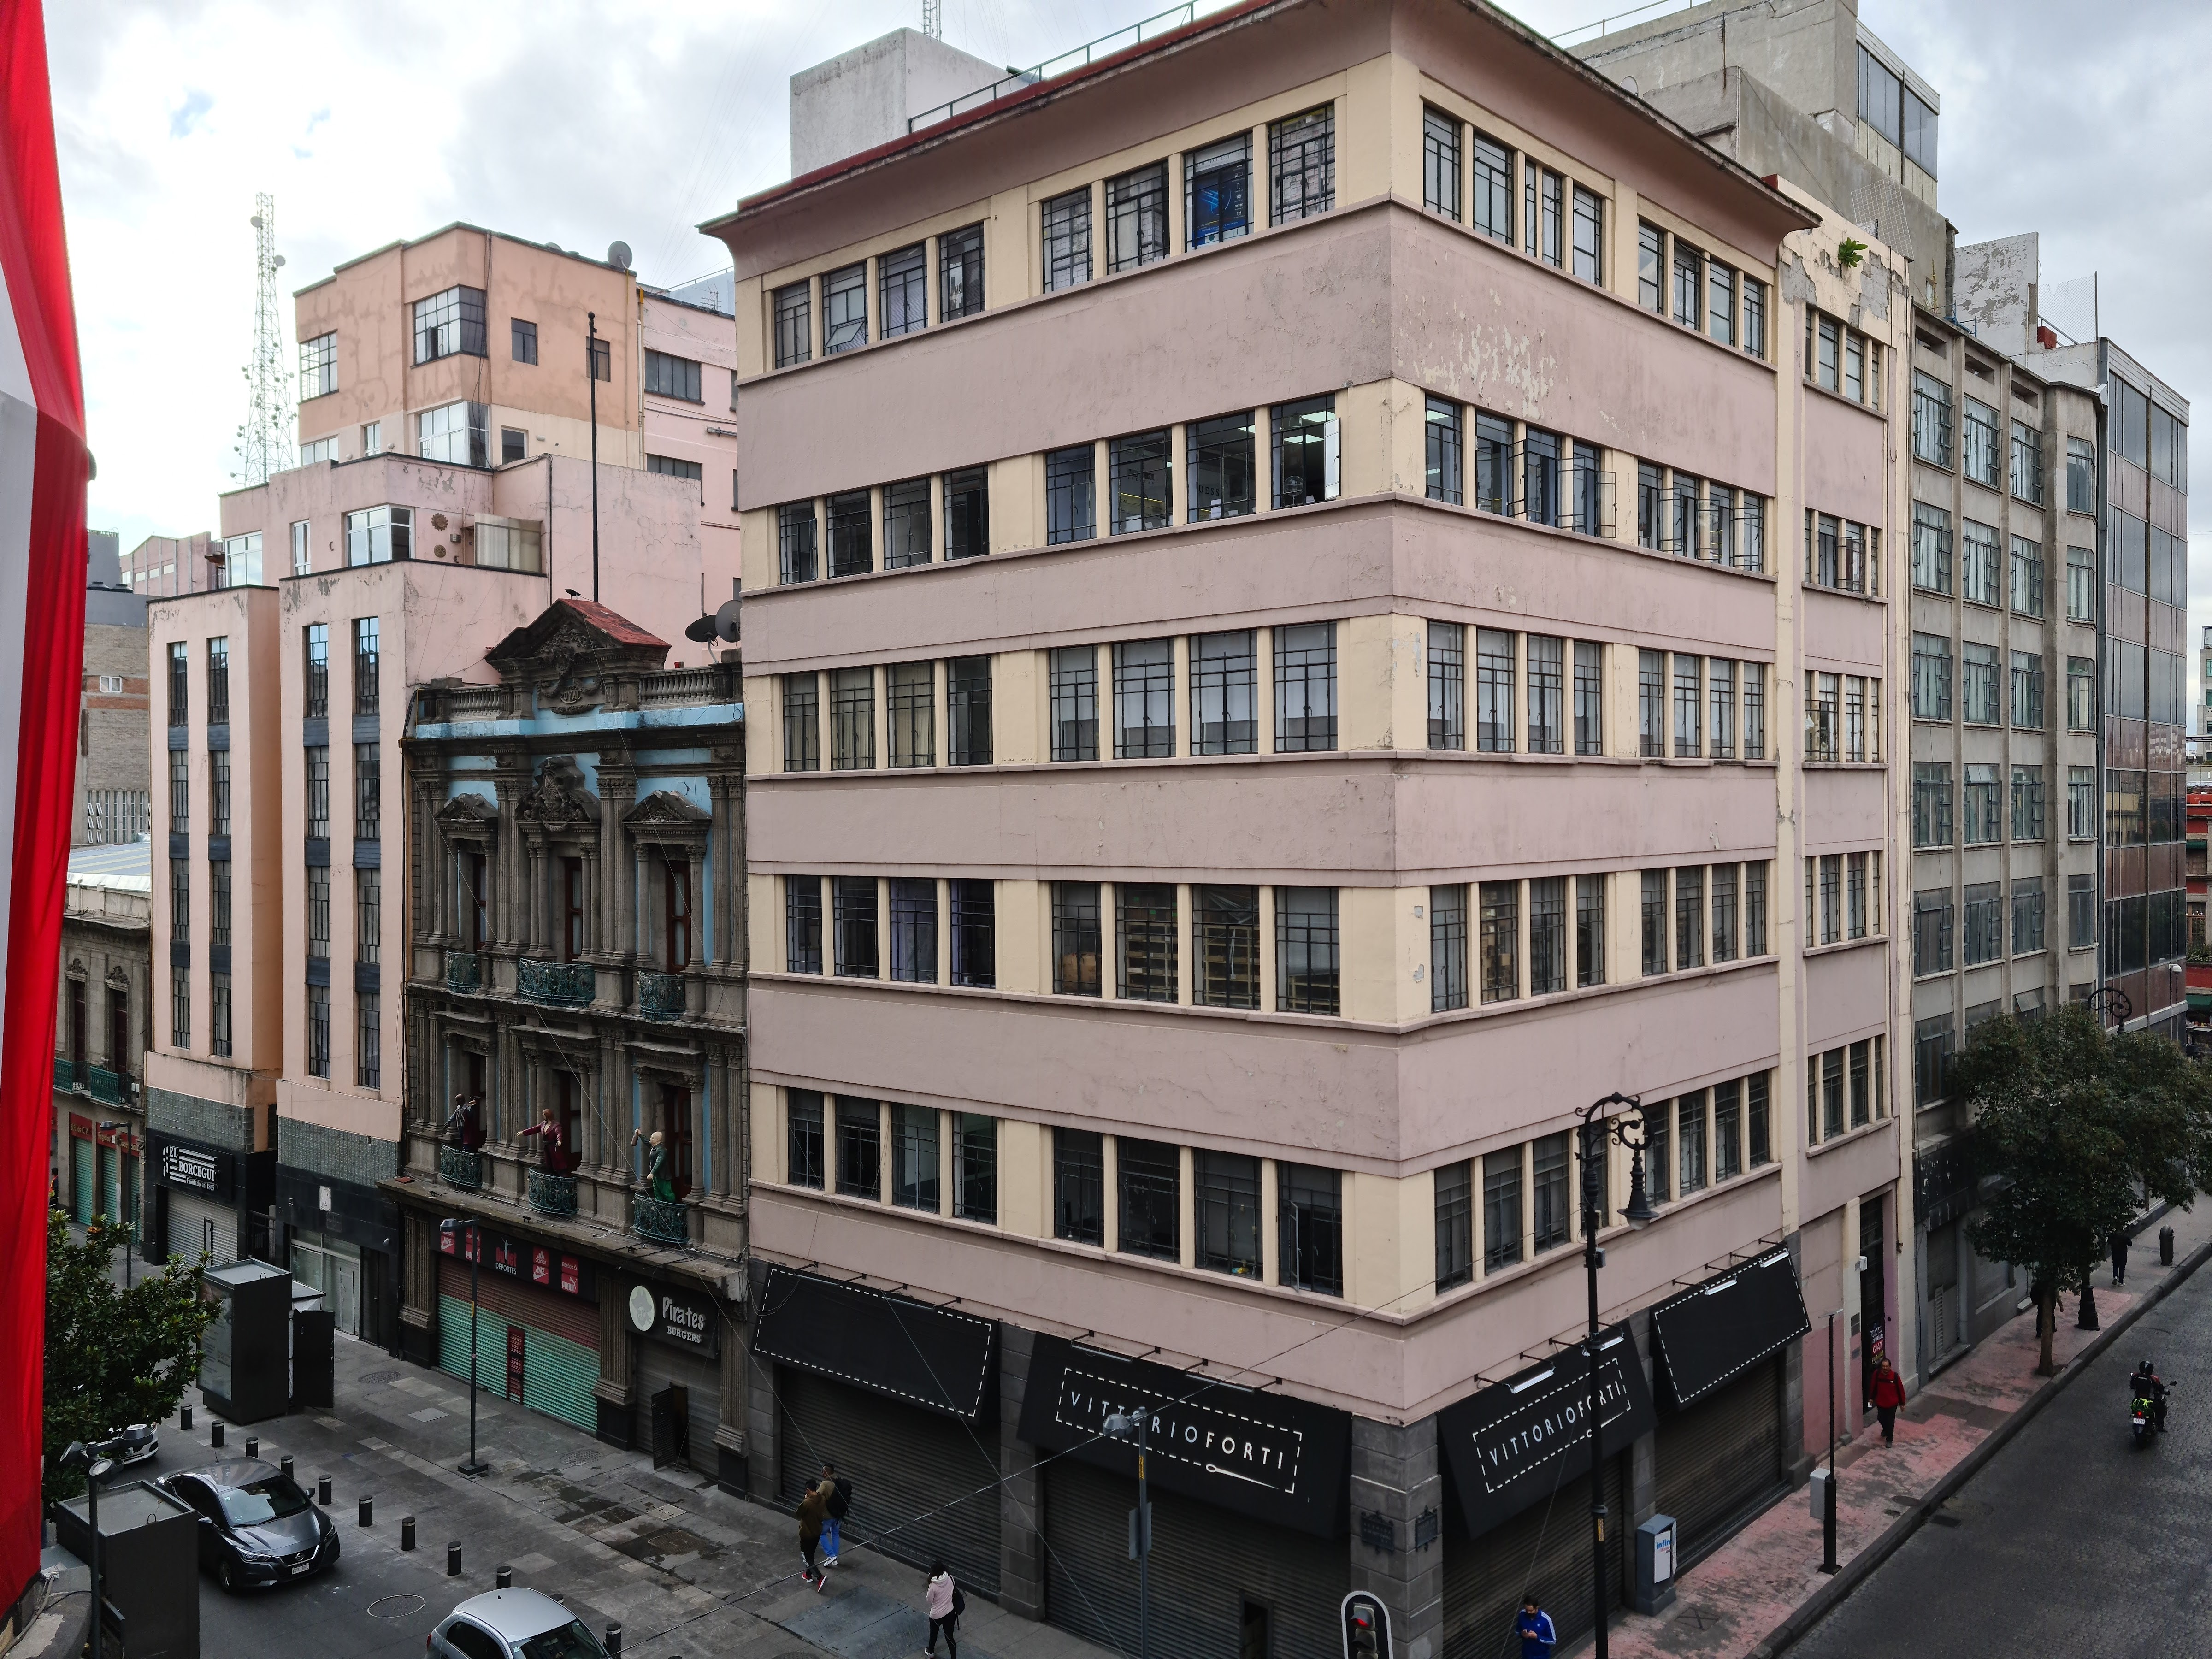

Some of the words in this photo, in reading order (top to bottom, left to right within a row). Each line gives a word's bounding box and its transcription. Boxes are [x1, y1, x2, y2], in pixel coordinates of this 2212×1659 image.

[1199, 485, 1219, 496] UESS
[169, 1146, 178, 1158] EL
[178, 1161, 215, 1181] BORCEGUI
[187, 1177, 201, 1187] Fundado
[495, 1262, 517, 1275] DEPORTES
[662, 1296, 706, 1330] Pirates
[667, 1325, 701, 1344] BURGERS
[1071, 1391, 1284, 1469] VITTRIOFORTI
